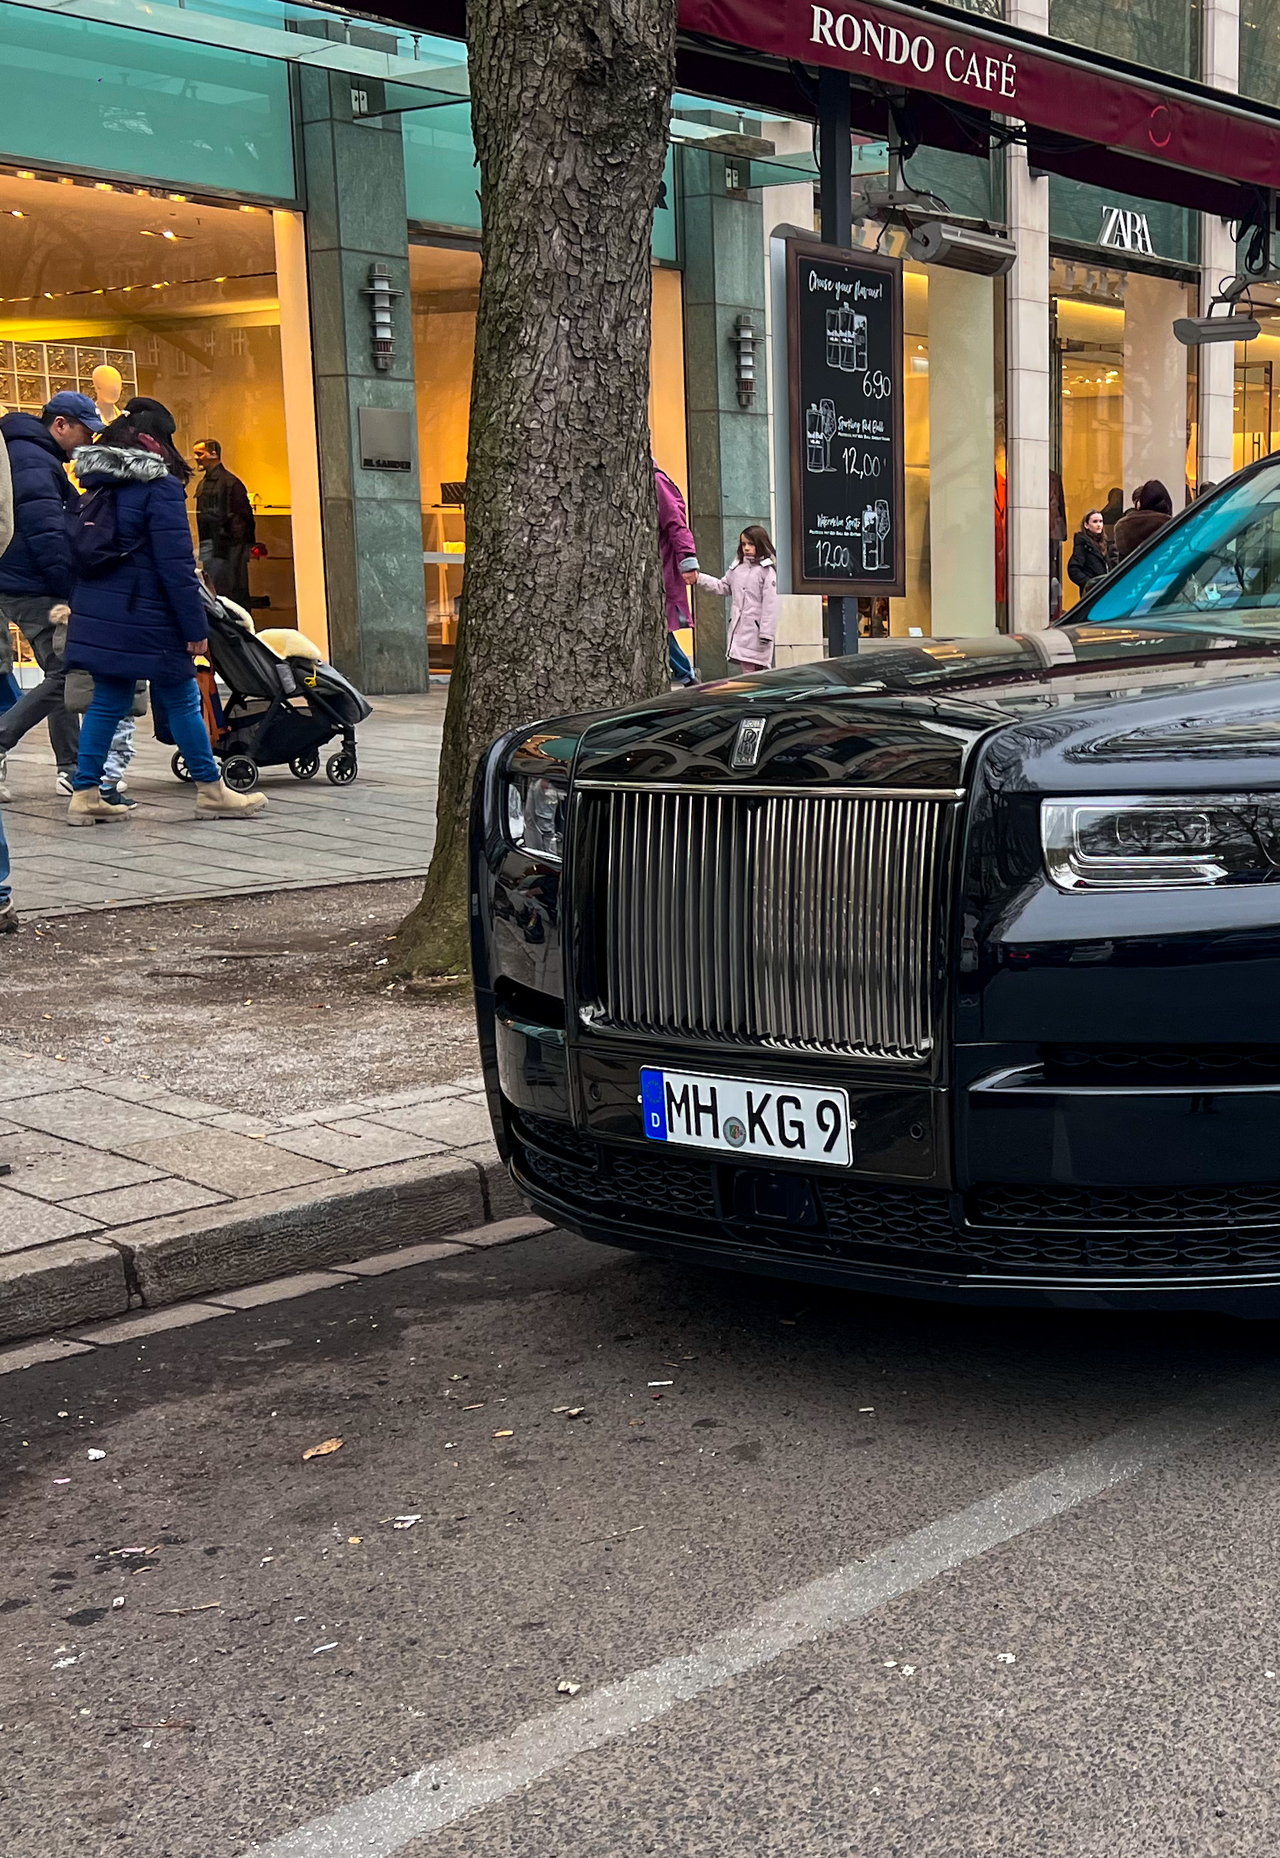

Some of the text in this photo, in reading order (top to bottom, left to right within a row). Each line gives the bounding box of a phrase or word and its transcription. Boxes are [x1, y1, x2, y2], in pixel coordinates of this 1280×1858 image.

[809, 4, 1017, 98] RONDO CAFÉ
[1099, 205, 1155, 257] ZARA
[651, 1113, 661, 1128] D
[665, 1081, 842, 1153] MH KG 9
